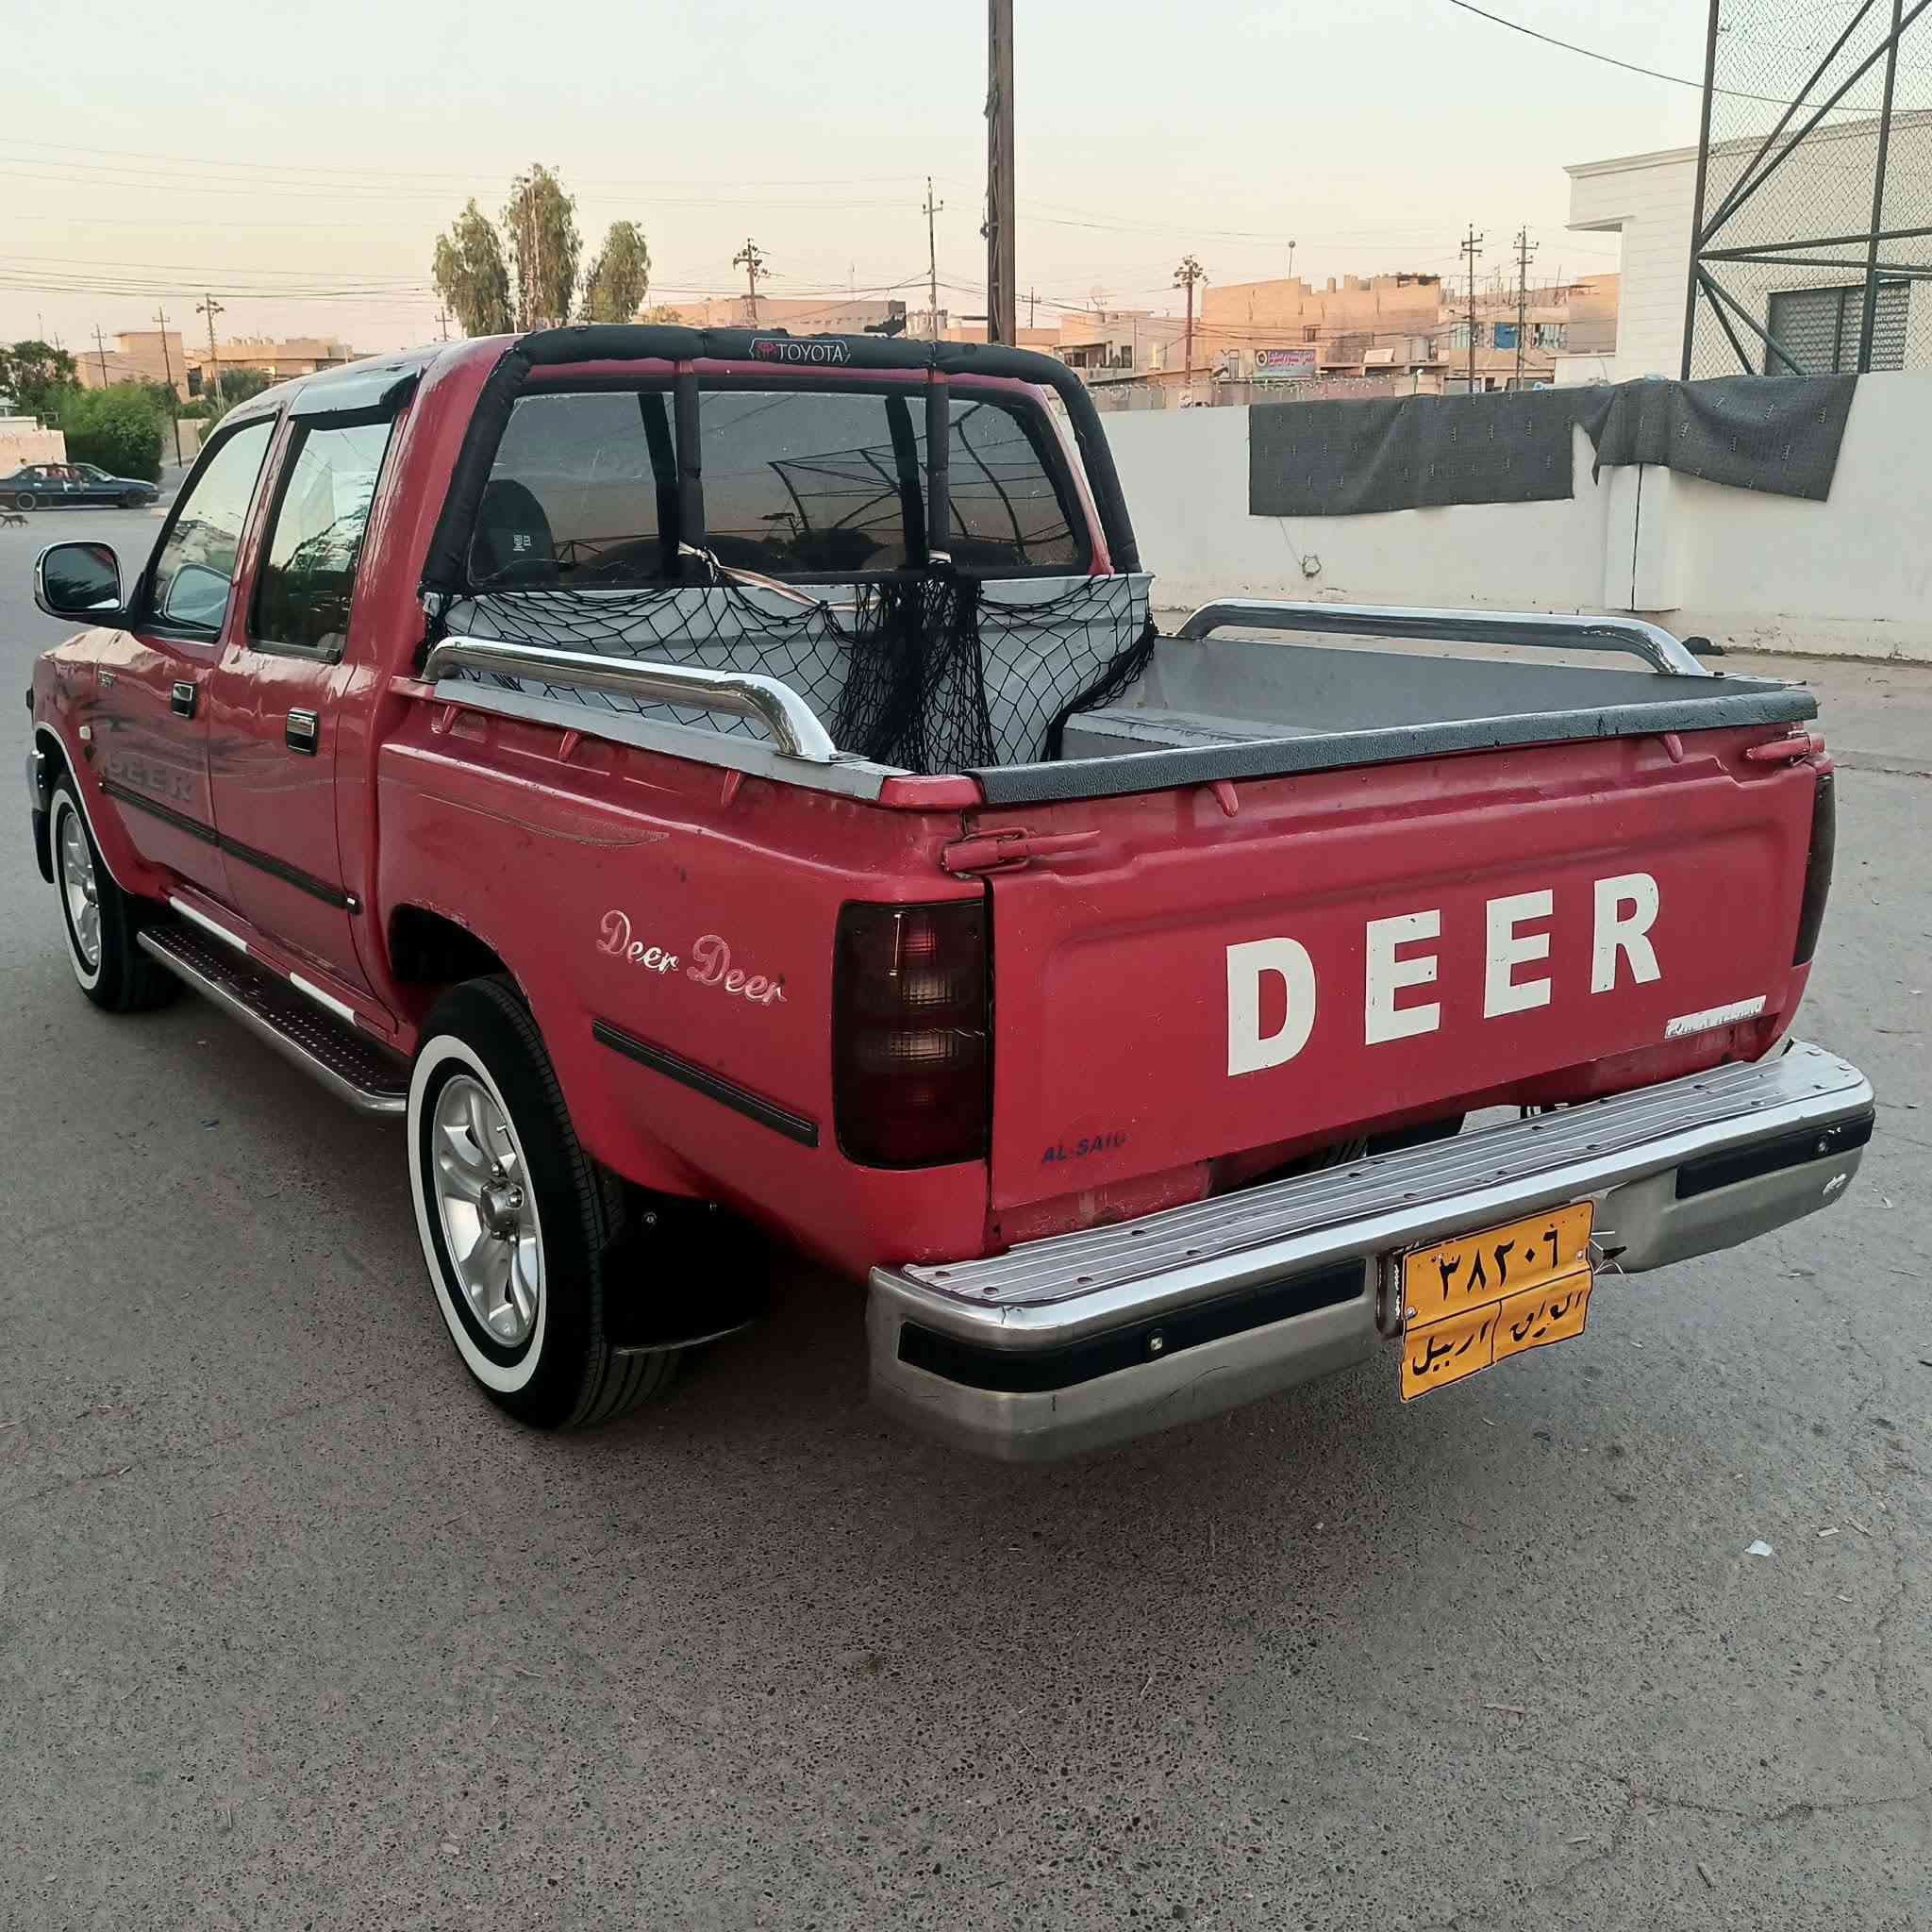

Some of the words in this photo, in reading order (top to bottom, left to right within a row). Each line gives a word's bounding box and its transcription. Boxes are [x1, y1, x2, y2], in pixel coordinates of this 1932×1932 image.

[775, 344, 843, 363] TOYOTA
[596, 909, 679, 974] Deer
[687, 934, 788, 1006] Deer
[1225, 872, 1661, 1077] DEER
[1439, 1226, 1558, 1301] ٣٨٢٠٦
